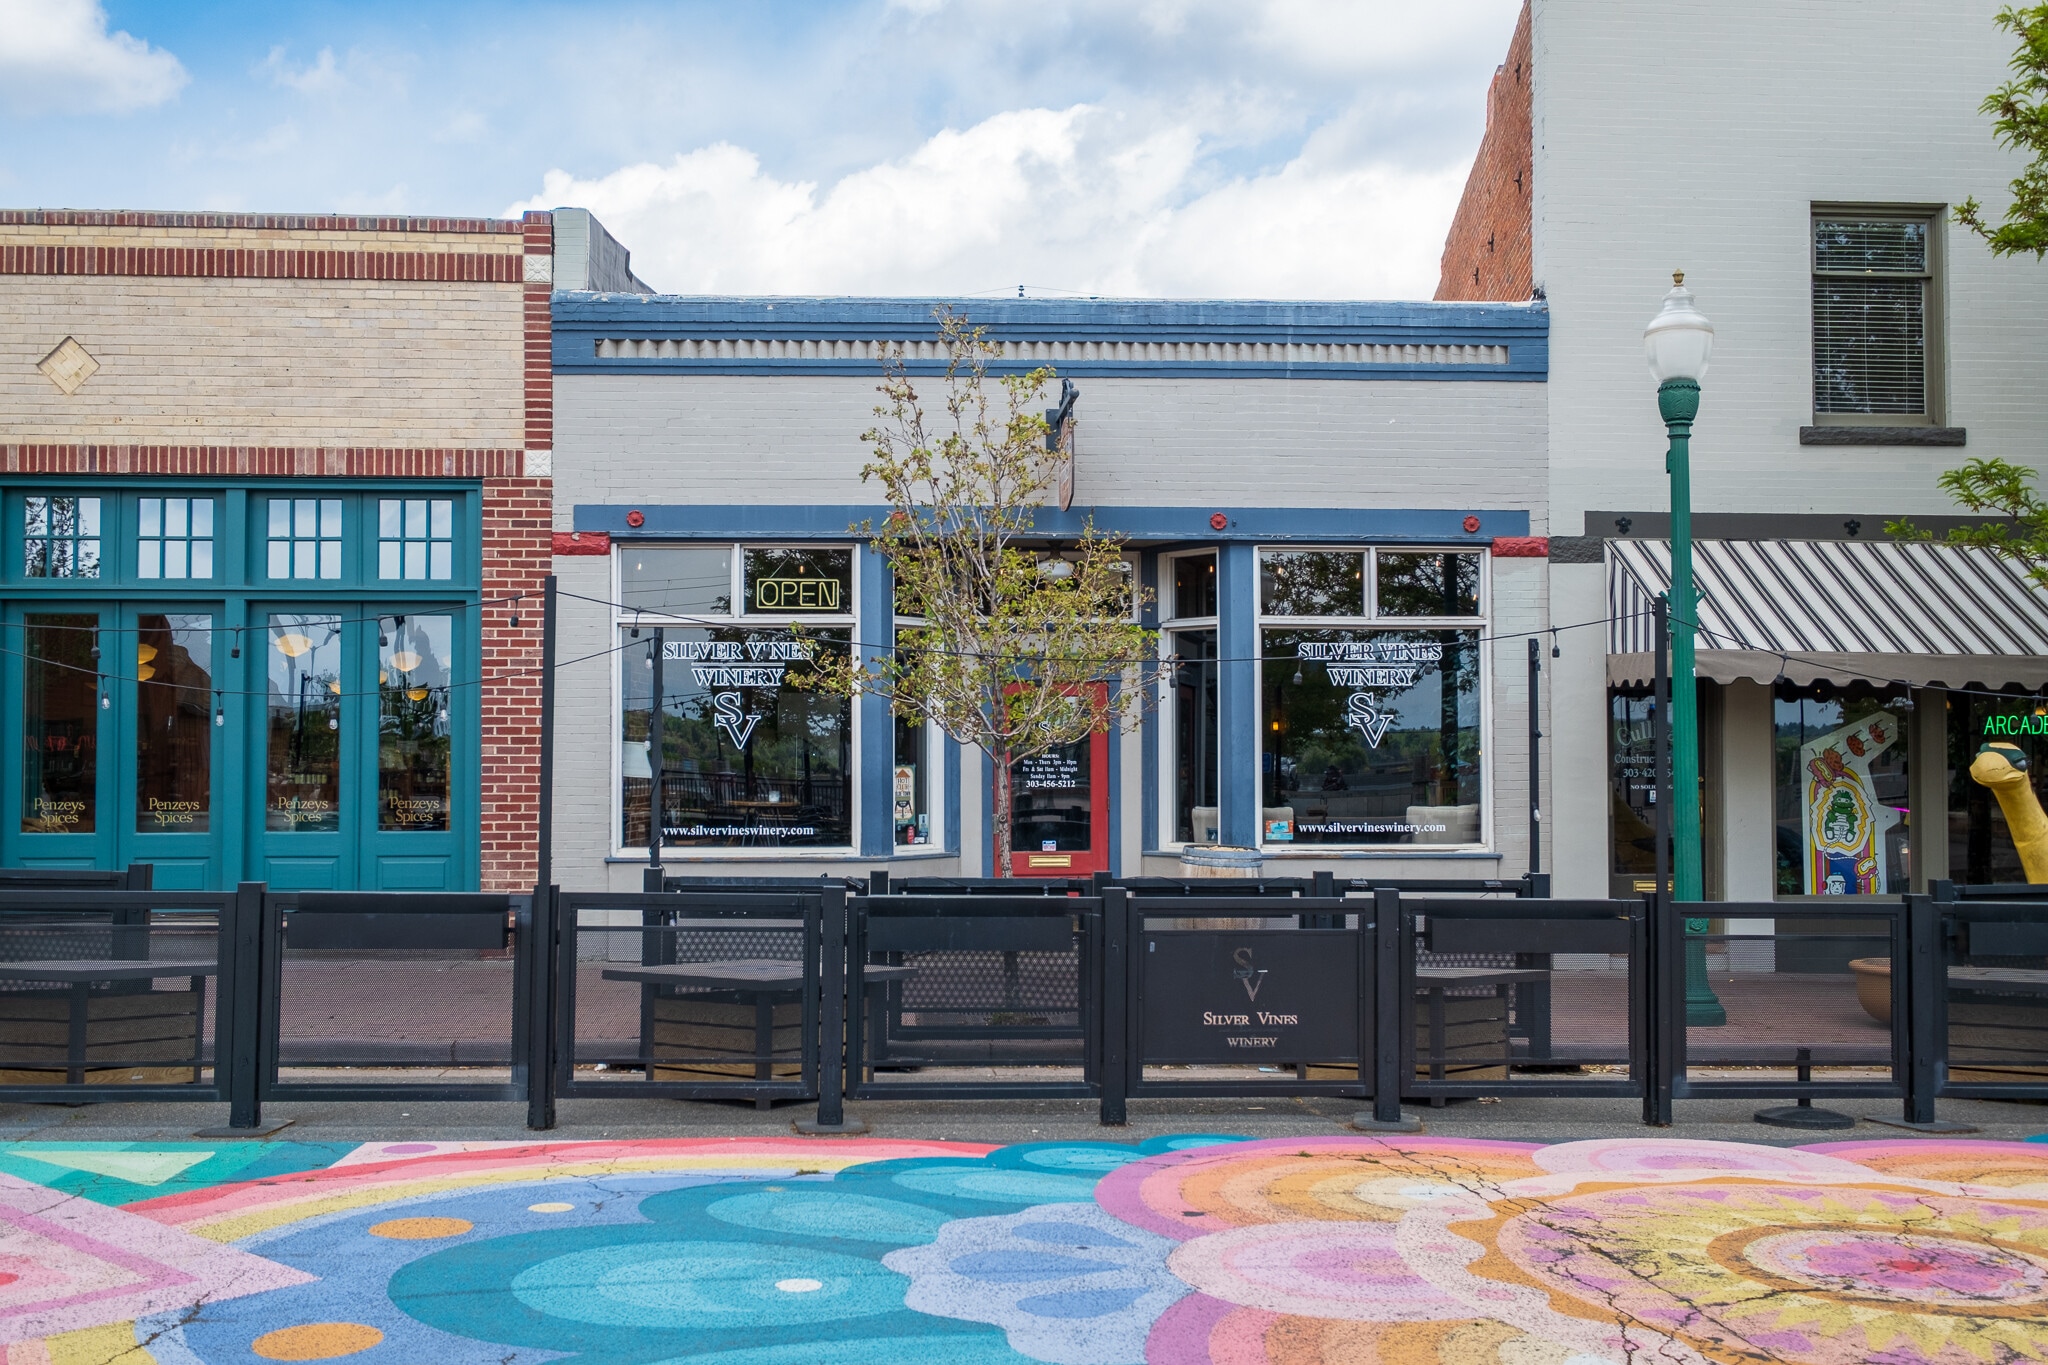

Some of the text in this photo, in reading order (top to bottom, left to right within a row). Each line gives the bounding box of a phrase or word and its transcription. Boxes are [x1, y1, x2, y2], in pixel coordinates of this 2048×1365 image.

[761, 581, 836, 606] OPEN
[663, 641, 743, 660] SILVER
[1298, 642, 1443, 660] SILVER VINES
[691, 668, 784, 687] WINERY
[1327, 668, 1416, 686] WINERY
[1026, 780, 1076, 788] 303-456-5212
[34, 797, 85, 812] Penzeys
[149, 797, 200, 812] Penzeys
[278, 797, 329, 812] Penzeys
[390, 796, 440, 811] Penzeys
[40, 811, 79, 827] Spices
[154, 811, 193, 827] Spices
[284, 810, 322, 826] Spices
[395, 809, 434, 825] Spices
[1298, 822, 1447, 835] www.silvervineswinery.com
[1227, 1037, 1278, 1048] WINERY
